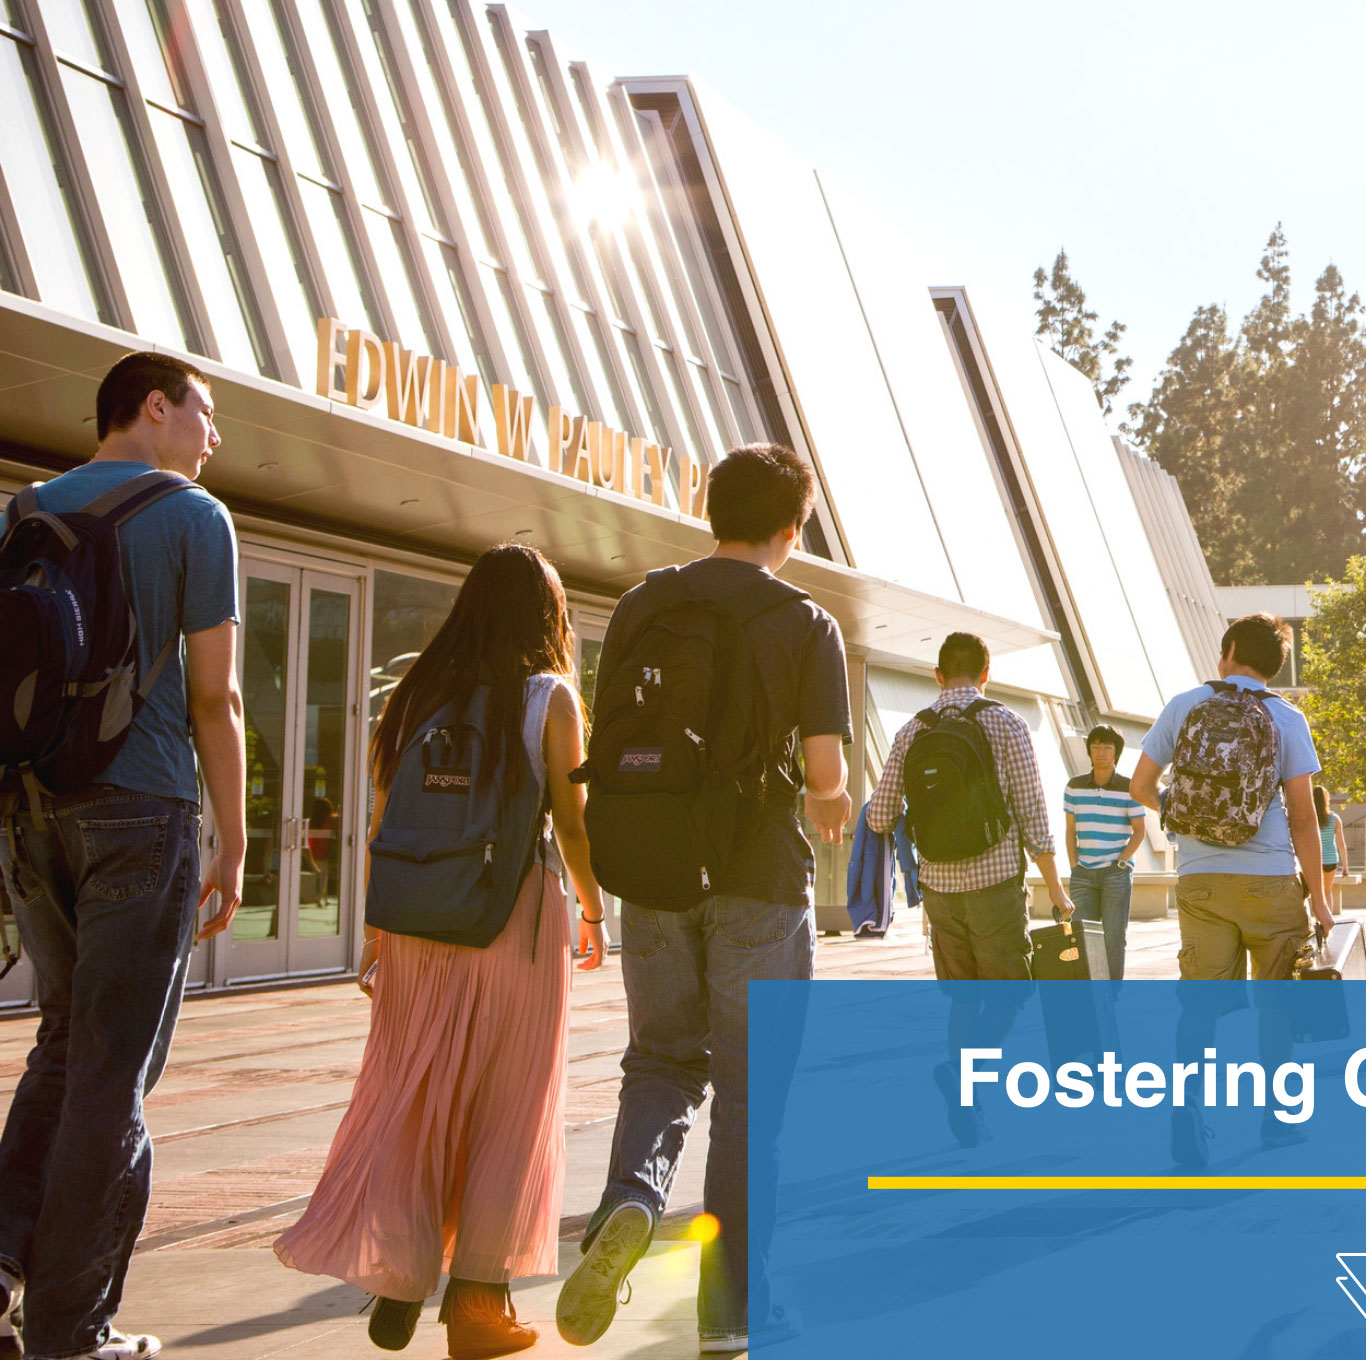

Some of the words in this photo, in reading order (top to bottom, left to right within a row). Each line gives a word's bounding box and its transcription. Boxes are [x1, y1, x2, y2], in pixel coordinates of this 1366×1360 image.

[317, 317, 480, 446] EDWIN
[492, 383, 536, 462] W
[548, 405, 672, 508] PAULEY
[65, 590, 82, 622] SIERRA
[76, 623, 85, 646] HIGH
